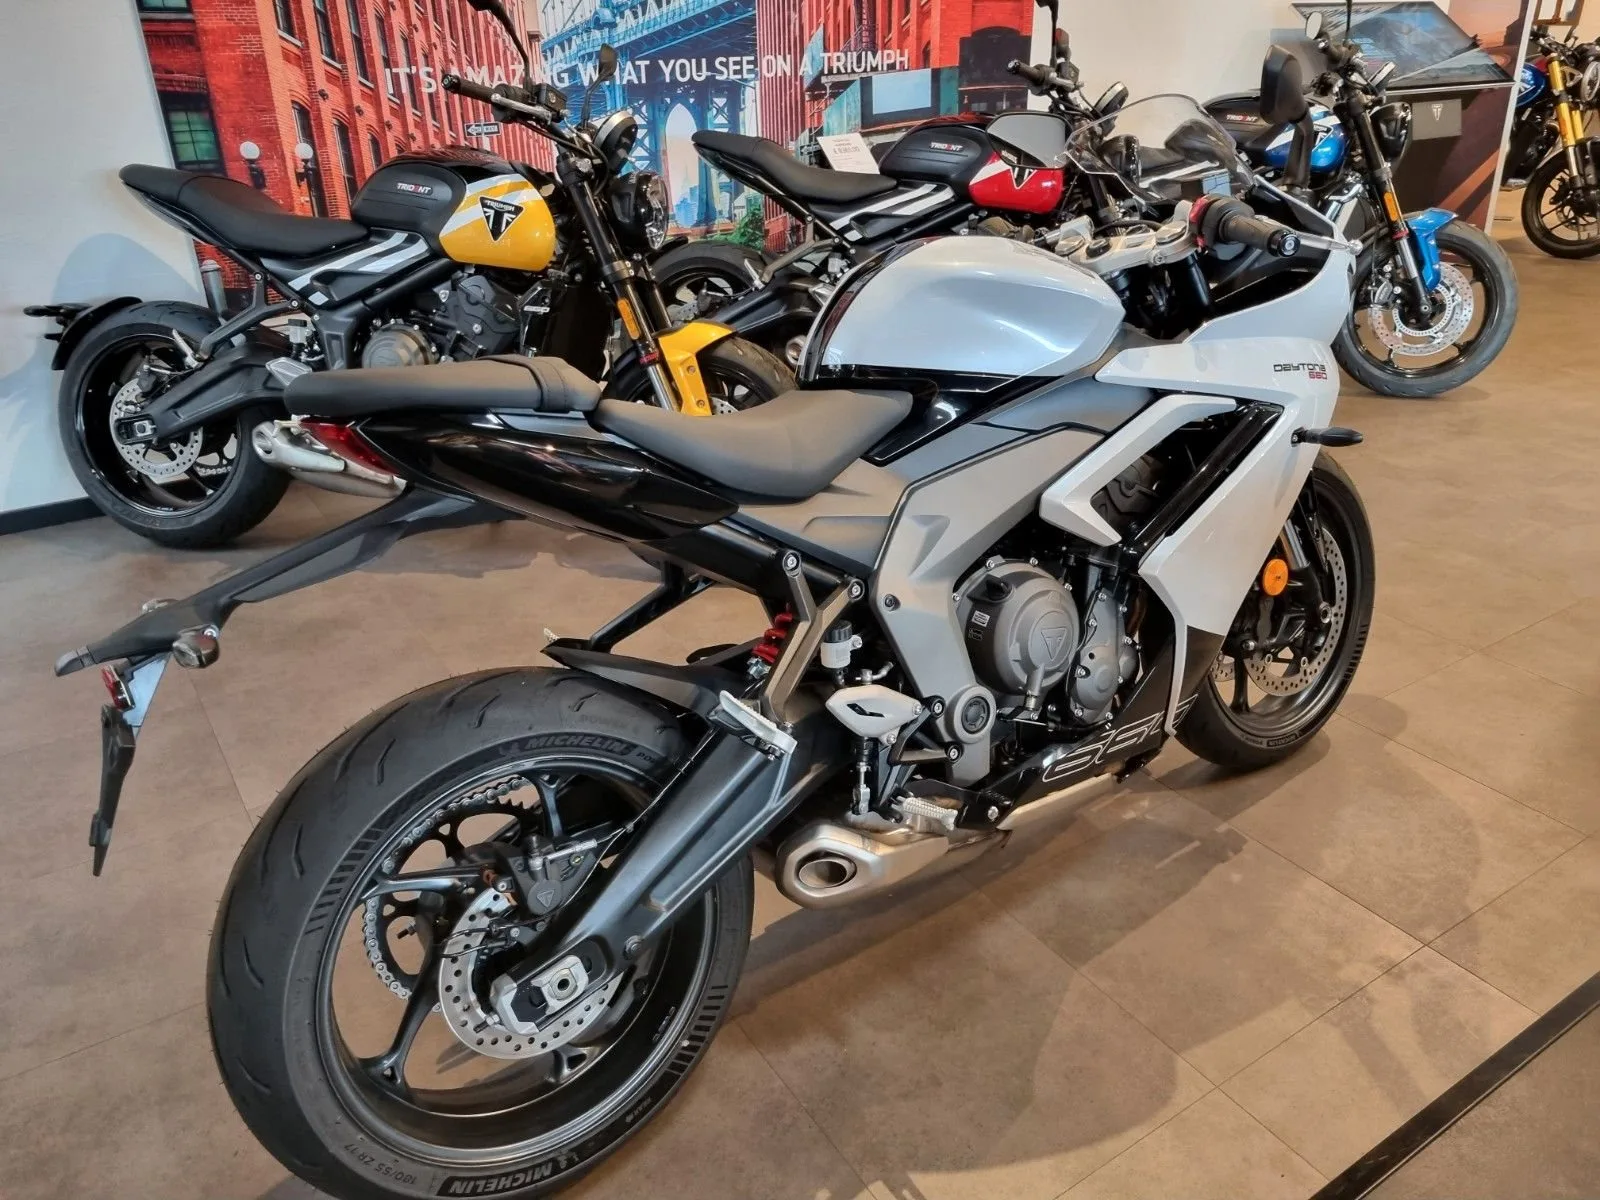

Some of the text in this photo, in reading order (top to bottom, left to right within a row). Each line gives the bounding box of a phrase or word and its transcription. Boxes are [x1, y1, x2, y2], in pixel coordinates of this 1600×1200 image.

[385, 65, 437, 93] IT'S
[658, 58, 707, 82] YOU
[715, 56, 754, 80] SEE
[763, 54, 791, 77] ON
[800, 53, 812, 76] A
[820, 49, 909, 75] TRIUMPH
[397, 182, 432, 194] TRIDENT
[486, 200, 515, 211] TRIUMPH
[524, 735, 627, 752] MICHELIN
[449, 1161, 552, 1194] MICHELIN
